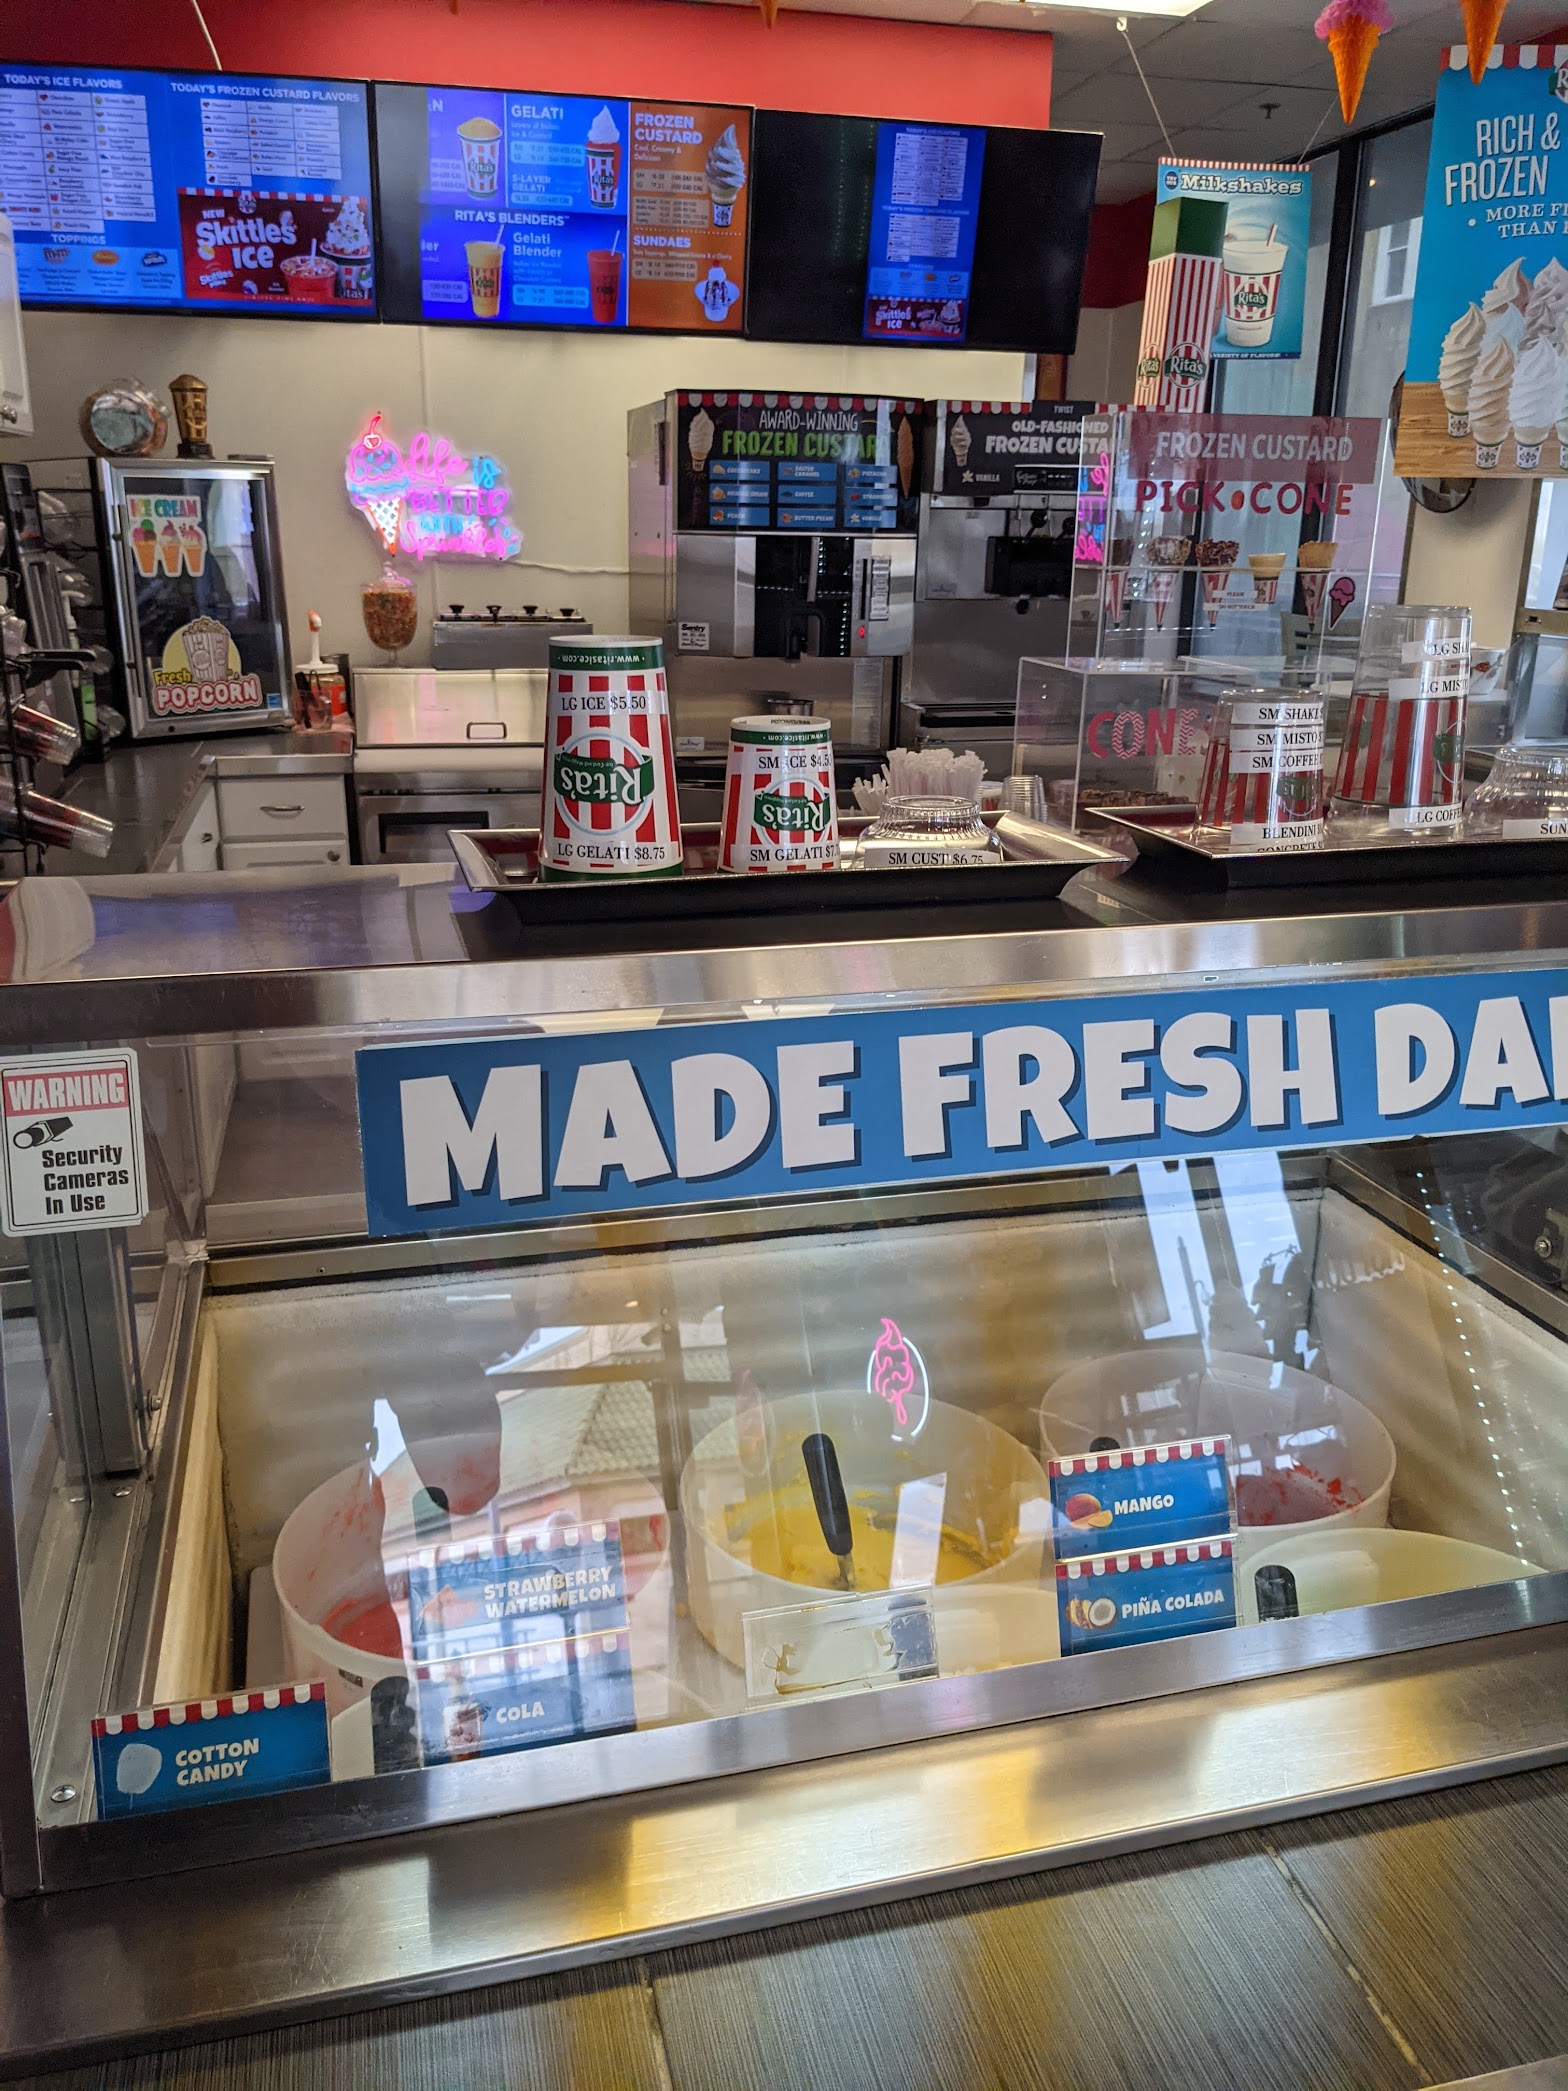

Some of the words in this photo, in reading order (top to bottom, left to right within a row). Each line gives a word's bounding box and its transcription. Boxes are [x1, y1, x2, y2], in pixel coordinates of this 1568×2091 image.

[4, 73, 50, 86] TODAY'S
[52, 76, 71, 87] ICE
[72, 77, 123, 90] FLAVORS
[170, 82, 216, 95] TODAY'S
[217, 85, 261, 98] FROZEN
[261, 87, 311, 101] CUSTARD
[311, 90, 360, 103] FLAVORS
[511, 105, 564, 120] GELATI
[635, 112, 695, 130] FROZEN
[634, 128, 703, 145] CUSTARD
[1476, 114, 1535, 158] RICH
[1540, 112, 1561, 150] &
[1180, 173, 1303, 196] Milkshakes
[1445, 155, 1549, 206] FROZEN
[202, 208, 225, 220] NEW
[455, 210, 497, 223] RITA'S
[1486, 203, 1544, 223] MORE
[51, 233, 107, 245] TOPPINGS
[196, 217, 298, 248] Skittles
[513, 232, 551, 245] Gelati
[1498, 220, 1557, 239] THAN
[513, 245, 562, 258] Blender
[633, 235, 692, 249] SUNDAES
[1237, 291, 1267, 305] Rita's
[1169, 358, 1205, 376] Rita's
[759, 410, 859, 432] AWARD-WINNING
[1011, 420, 1109, 434] OLD-FASHIONED
[722, 430, 799, 457] FROZEN
[985, 435, 1054, 454] FROZEN
[1156, 432, 1247, 460] FROZEN
[1252, 434, 1353, 462] CUSTARD
[472, 456, 502, 489] is
[975, 473, 1000, 482] VANILLA
[1135, 480, 1226, 513] PICK
[1250, 482, 1354, 516] CONE
[131, 499, 153, 518] ICE
[154, 499, 199, 519] CREAM
[681, 623, 706, 632] Sentry
[1434, 642, 1450, 656] LG
[153, 669, 193, 686] Fresh
[156, 677, 261, 712] POPCORN
[1421, 681, 1439, 694] LG
[561, 697, 578, 711] LG
[581, 696, 606, 710] ICE
[1258, 707, 1280, 720] SM
[1086, 708, 1198, 760] CONE
[1257, 733, 1277, 745] SM
[1282, 731, 1318, 745] MISTO
[758, 756, 780, 769] SM
[785, 755, 808, 769] CE
[1252, 756, 1273, 769] SM
[1278, 753, 1318, 768] COFFEE
[560, 765, 642, 806] Rita's
[762, 801, 828, 832] Rita's
[1416, 811, 1433, 824] LG
[1262, 825, 1316, 839] BLENDINI
[558, 842, 573, 858] LG
[576, 844, 631, 861] GELATI
[634, 845, 666, 860] $8.75
[750, 850, 770, 862] SM
[775, 846, 824, 861] GELATI
[888, 851, 908, 865] SM
[911, 851, 947, 865] CUST
[8, 1072, 126, 1112] WARNING
[400, 1039, 858, 1209] MADE
[898, 1007, 1342, 1162] FRESH
[42, 1145, 123, 1169] Security
[44, 1169, 129, 1192] Cameras
[45, 1196, 64, 1216] In
[71, 1194, 106, 1213] Use
[1114, 1494, 1175, 1516] MANGO
[484, 1565, 613, 1601] STRAWBERRY
[485, 1583, 617, 1619] WATERMELON
[1121, 1596, 1162, 1619] PIÑA
[1165, 1588, 1225, 1611] COLADA
[495, 1701, 546, 1724] COLA
[174, 1737, 260, 1768] COTTON
[175, 1759, 249, 1788] CANDY
